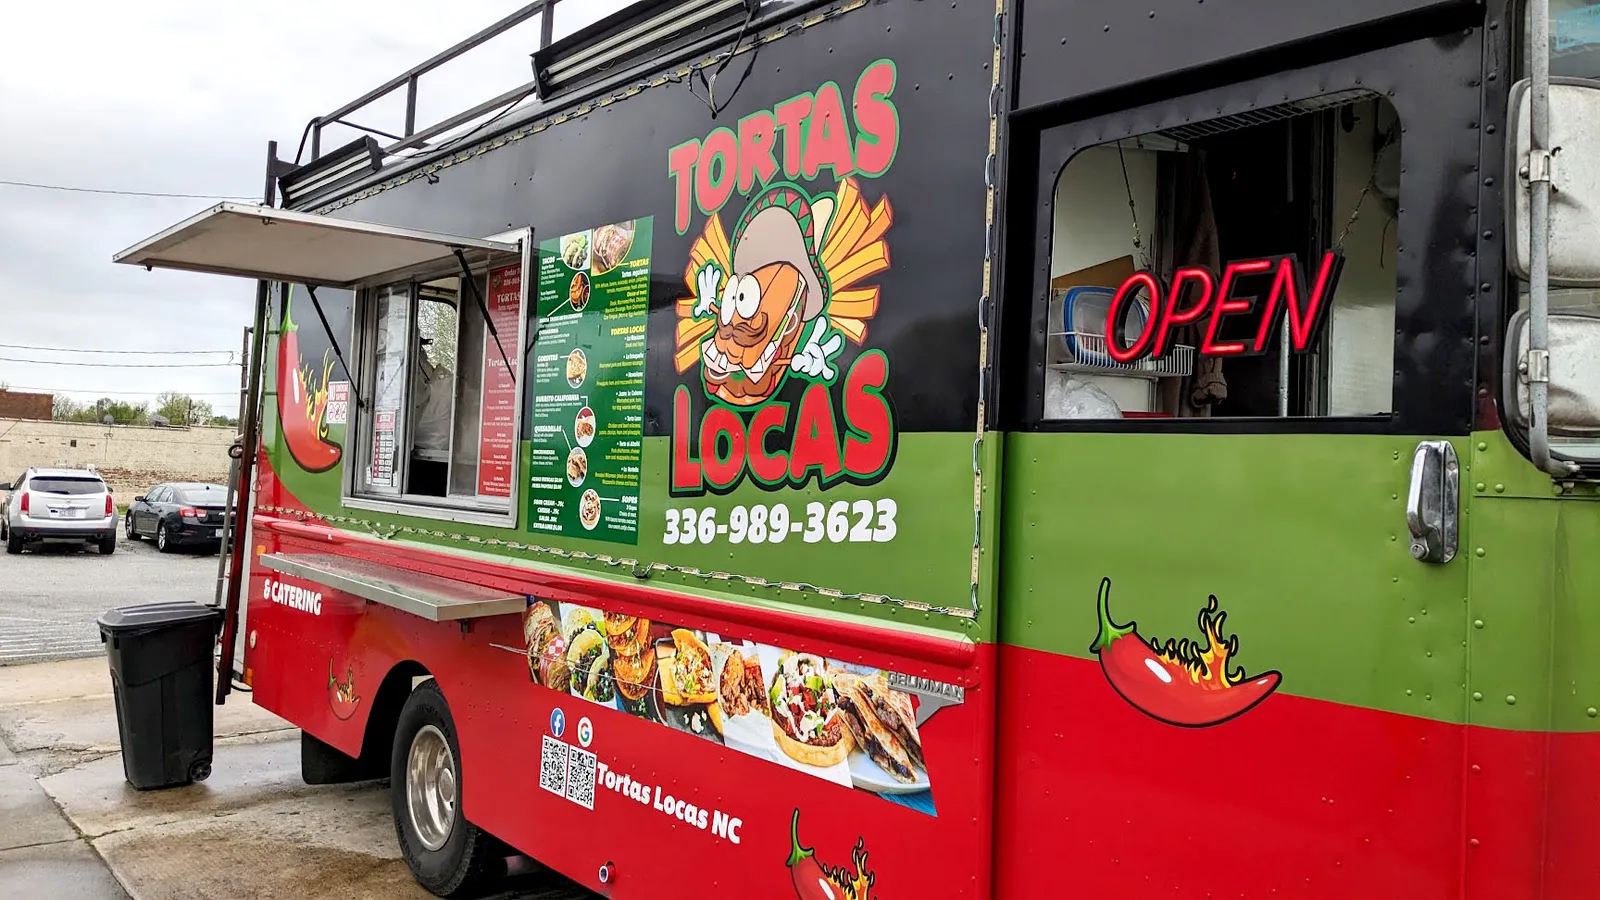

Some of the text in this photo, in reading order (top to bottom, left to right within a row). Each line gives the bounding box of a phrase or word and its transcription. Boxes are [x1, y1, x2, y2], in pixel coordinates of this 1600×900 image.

[668, 58, 900, 236] TORTAS
[542, 256, 555, 265] TACOS
[629, 258, 649, 268] TORTAS
[1105, 251, 1340, 364] OPEN
[610, 325, 645, 336] TORTAS LOCAS
[537, 354, 558, 362] GORDITAS
[534, 425, 562, 433] QUESADILLAS
[671, 348, 897, 495] LOCAS
[621, 495, 638, 504] SOPES
[663, 498, 898, 545] 336-989-3623
[263, 578, 322, 616] & CATERING
[597, 761, 743, 845] Tortas Locas NC
